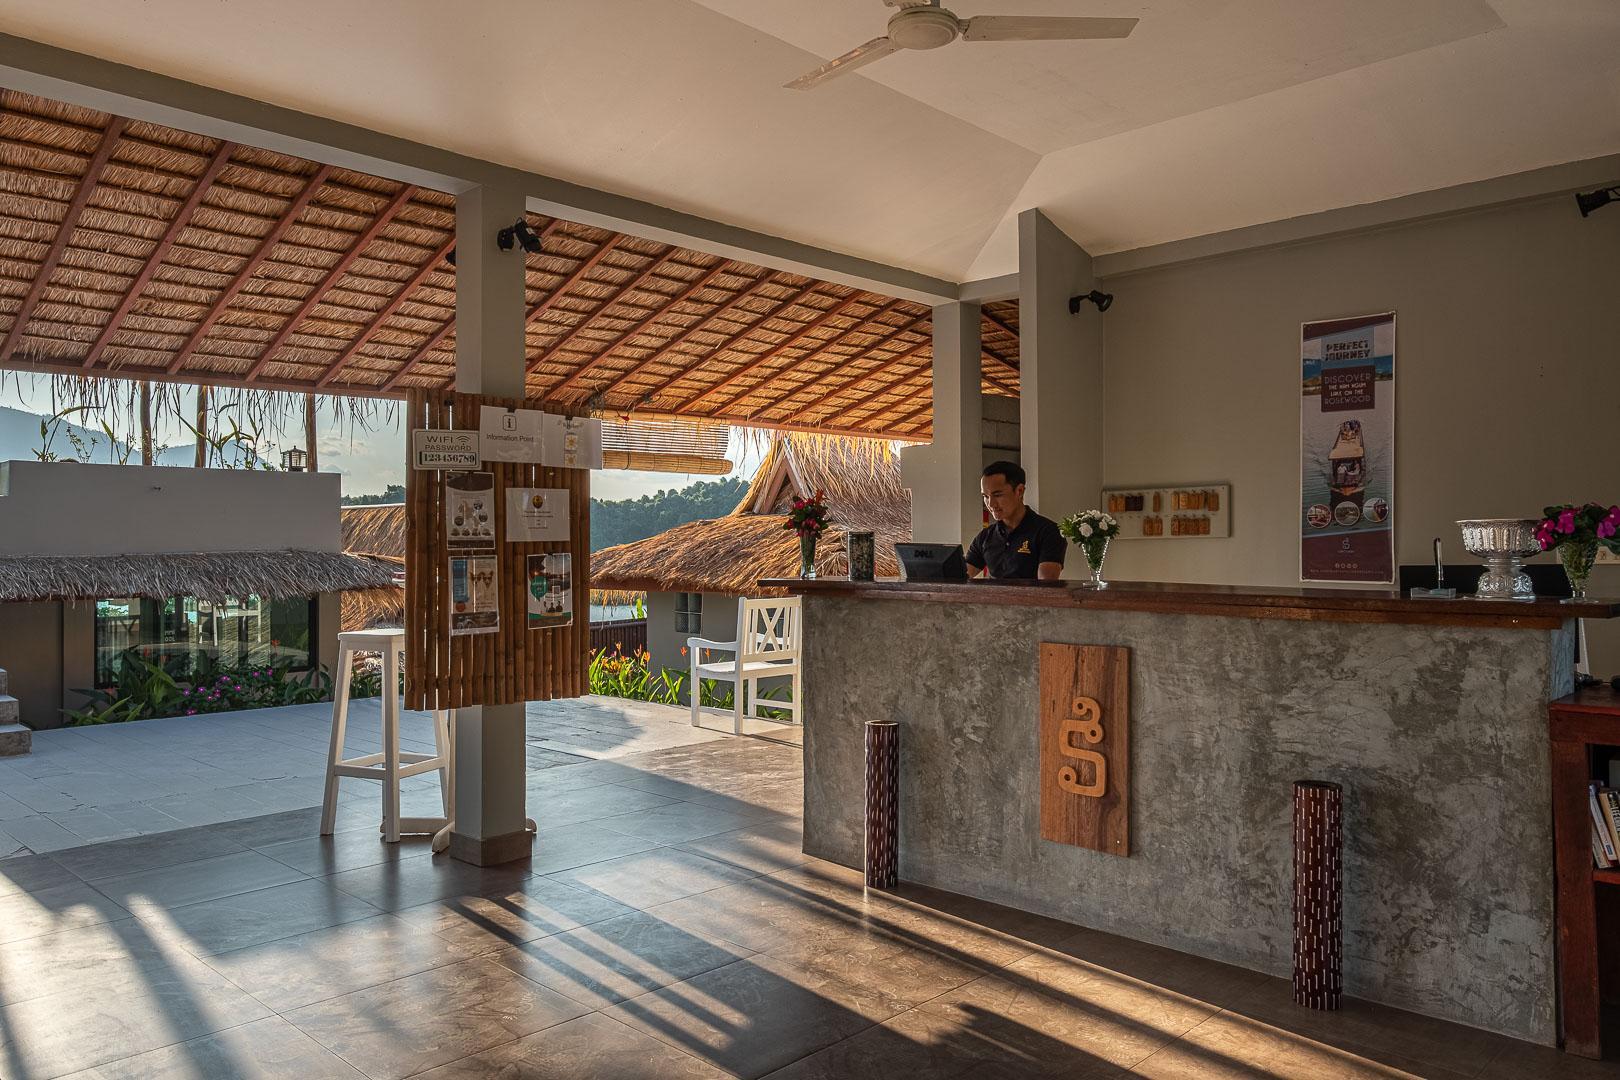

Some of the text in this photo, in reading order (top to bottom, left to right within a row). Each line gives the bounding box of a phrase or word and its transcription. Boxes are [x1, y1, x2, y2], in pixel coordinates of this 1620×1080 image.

[1326, 340, 1369, 352] PERFECT
[1324, 349, 1371, 361] JOURNEY
[1324, 373, 1371, 385] DISCOVER
[1324, 395, 1371, 405] ROSEWOOD
[486, 434, 518, 442] Information
[424, 453, 475, 463] 123456789
[914, 549, 934, 558] DELL
